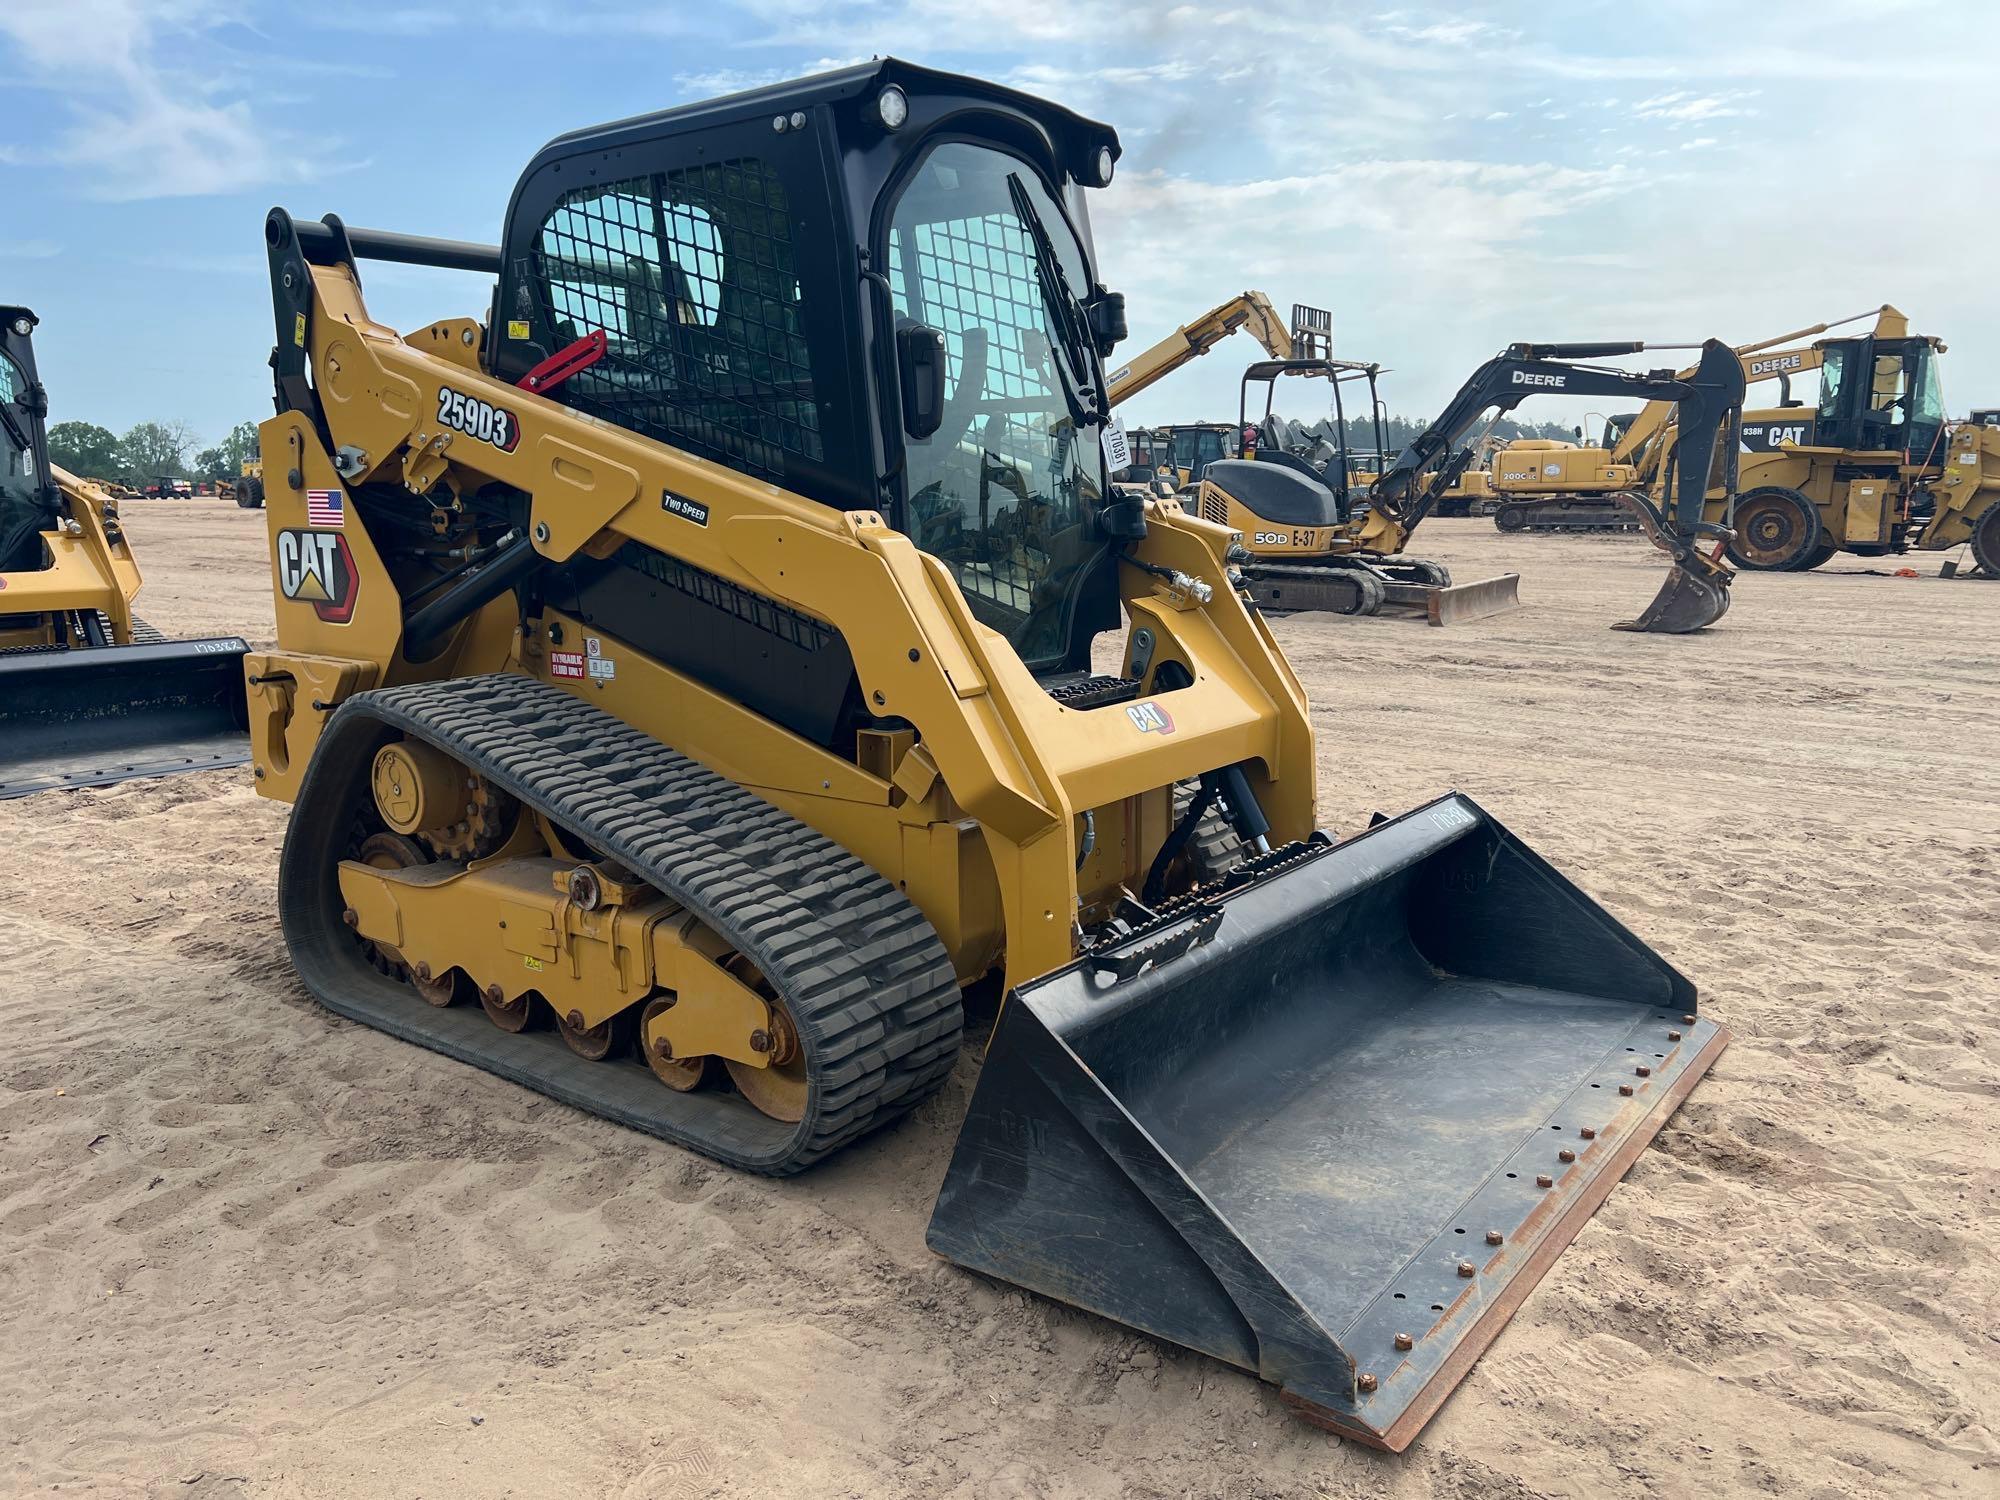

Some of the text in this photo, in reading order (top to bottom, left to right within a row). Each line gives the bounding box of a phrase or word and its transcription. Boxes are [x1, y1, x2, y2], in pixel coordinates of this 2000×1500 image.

[1751, 355, 1800, 375] DEERE
[1512, 370, 1566, 387] DEERE
[436, 387, 508, 448] 259D3
[1743, 428, 1763, 436] 938H
[1769, 427, 1805, 447] CAT
[1110, 430, 1127, 464] 170381
[1504, 472, 1526, 480] 200C
[1255, 532, 1288, 544] 50D
[1292, 530, 1315, 546] E-37
[278, 531, 337, 601] CAT
[1126, 702, 1166, 732] CAT
[1428, 805, 1477, 832] 170381
